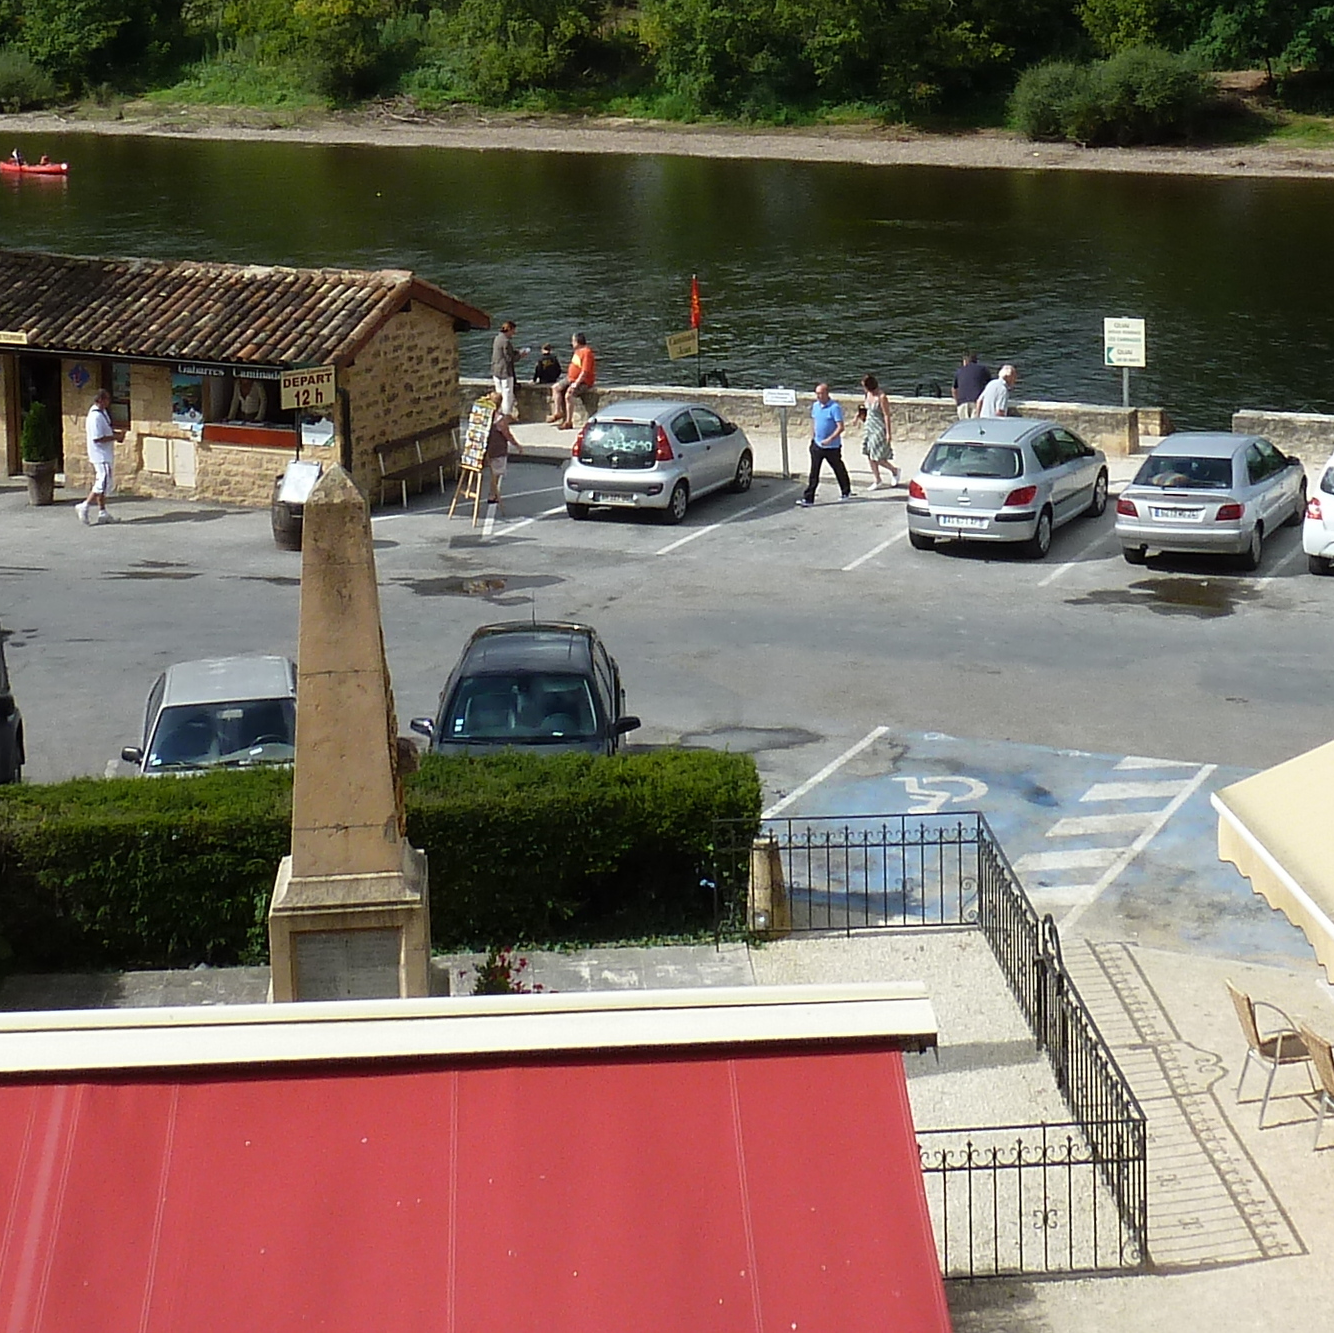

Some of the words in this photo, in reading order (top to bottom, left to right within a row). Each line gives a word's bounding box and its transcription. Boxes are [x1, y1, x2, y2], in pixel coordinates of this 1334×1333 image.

[283, 372, 333, 388] DEPART
[294, 389, 311, 407] 12
[315, 387, 324, 404] h
